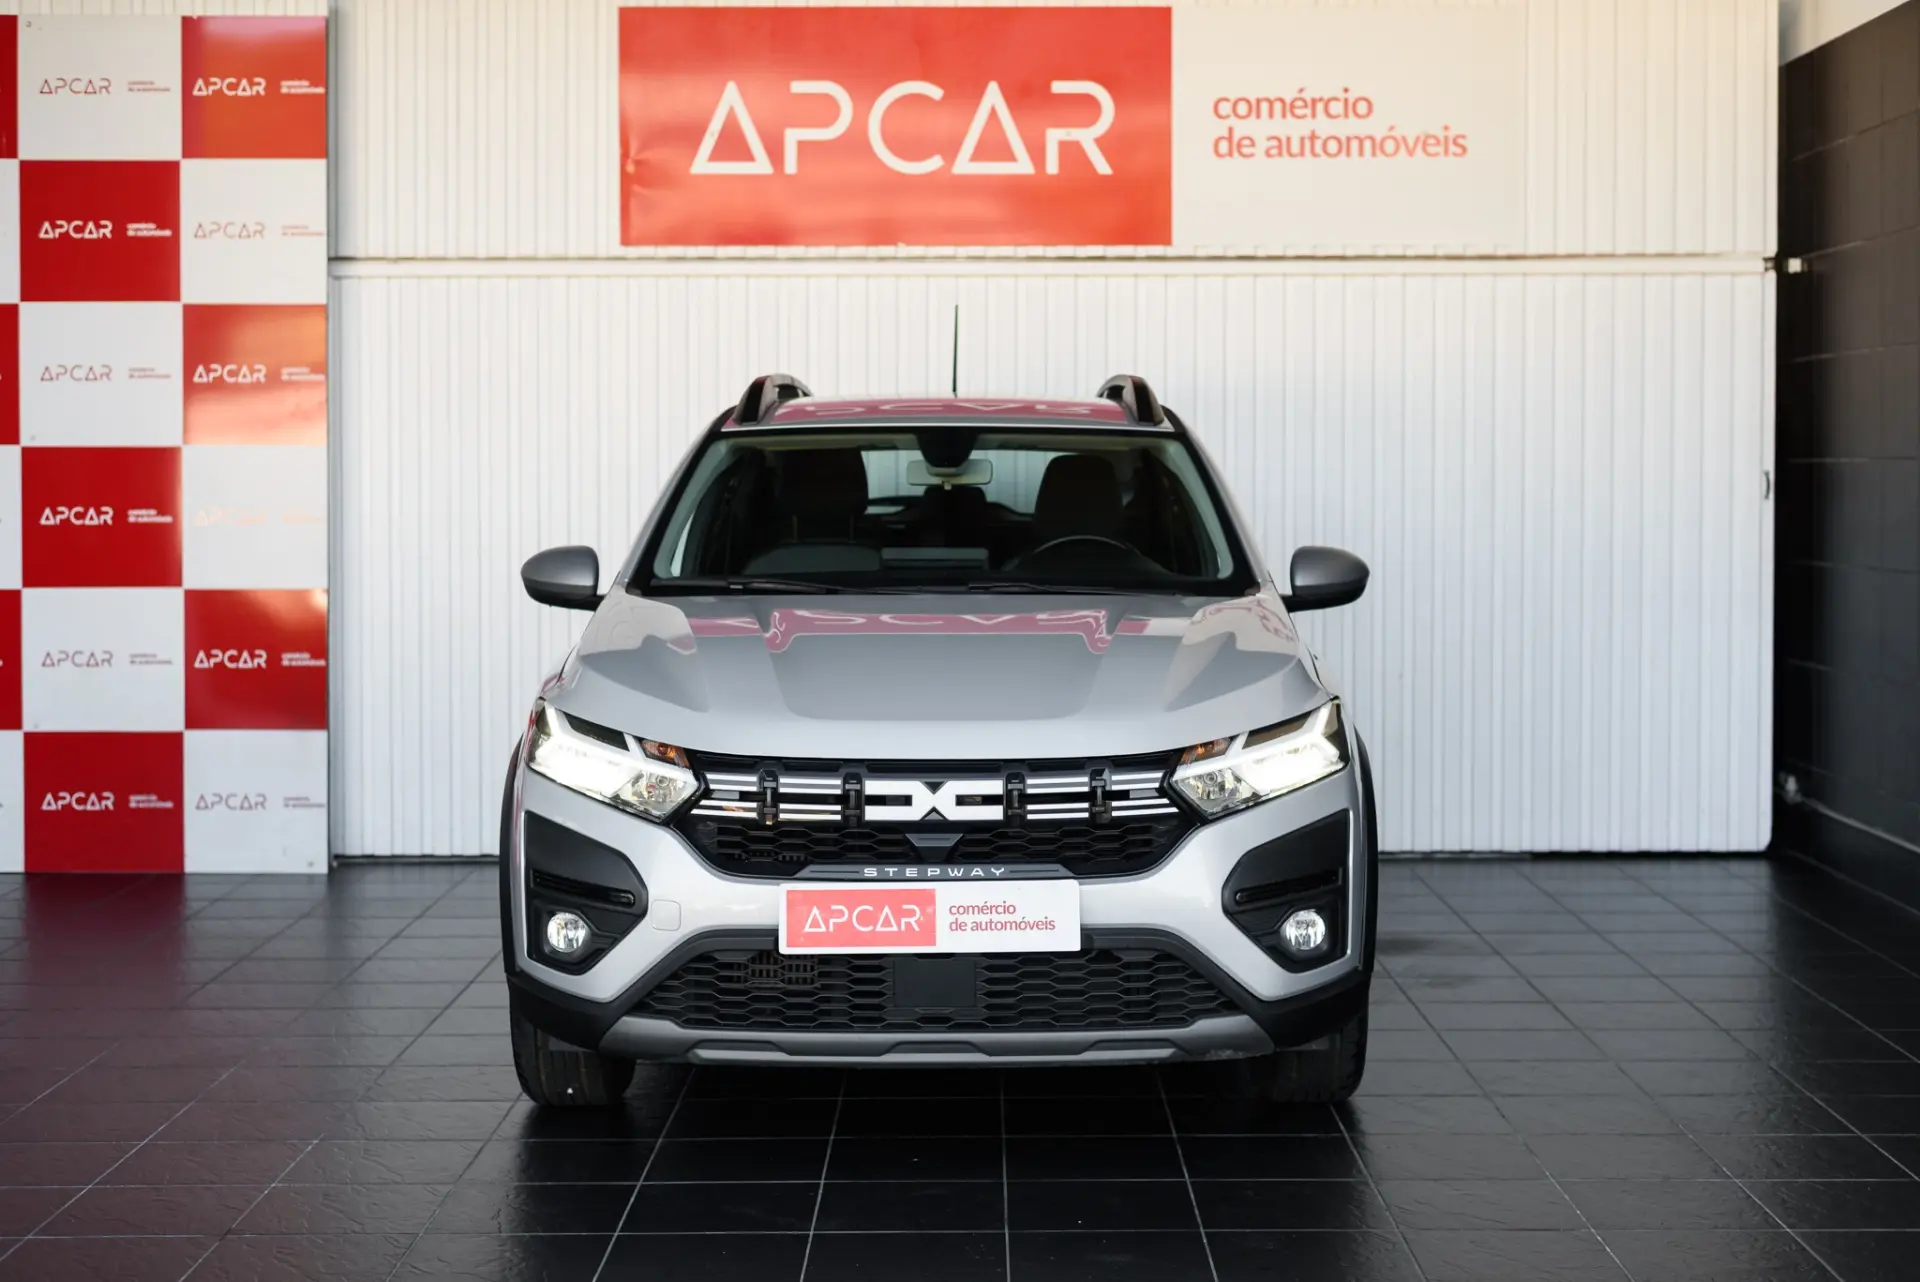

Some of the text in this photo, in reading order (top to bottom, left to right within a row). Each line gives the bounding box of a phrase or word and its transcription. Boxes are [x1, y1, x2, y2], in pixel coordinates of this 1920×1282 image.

[39, 78, 112, 95] APCAR
[192, 77, 267, 97] APCAR
[1212, 87, 1374, 120] comércio
[689, 80, 1116, 176] APCAR
[1212, 124, 1468, 159] de automóveis
[38, 220, 113, 239] APCAR
[193, 221, 266, 239] APCAR
[40, 364, 113, 382] APCAR
[192, 364, 267, 383] APCAR
[39, 506, 114, 526] APCAR
[41, 650, 114, 668] APCAR
[193, 649, 267, 669] APCAR
[41, 791, 115, 811] APCAR
[194, 792, 267, 811] APCAR
[863, 867, 1005, 877] STEPWAY
[948, 900, 1017, 916] comércio
[803, 904, 921, 933] APCAR
[949, 916, 1056, 932] de automóveis
